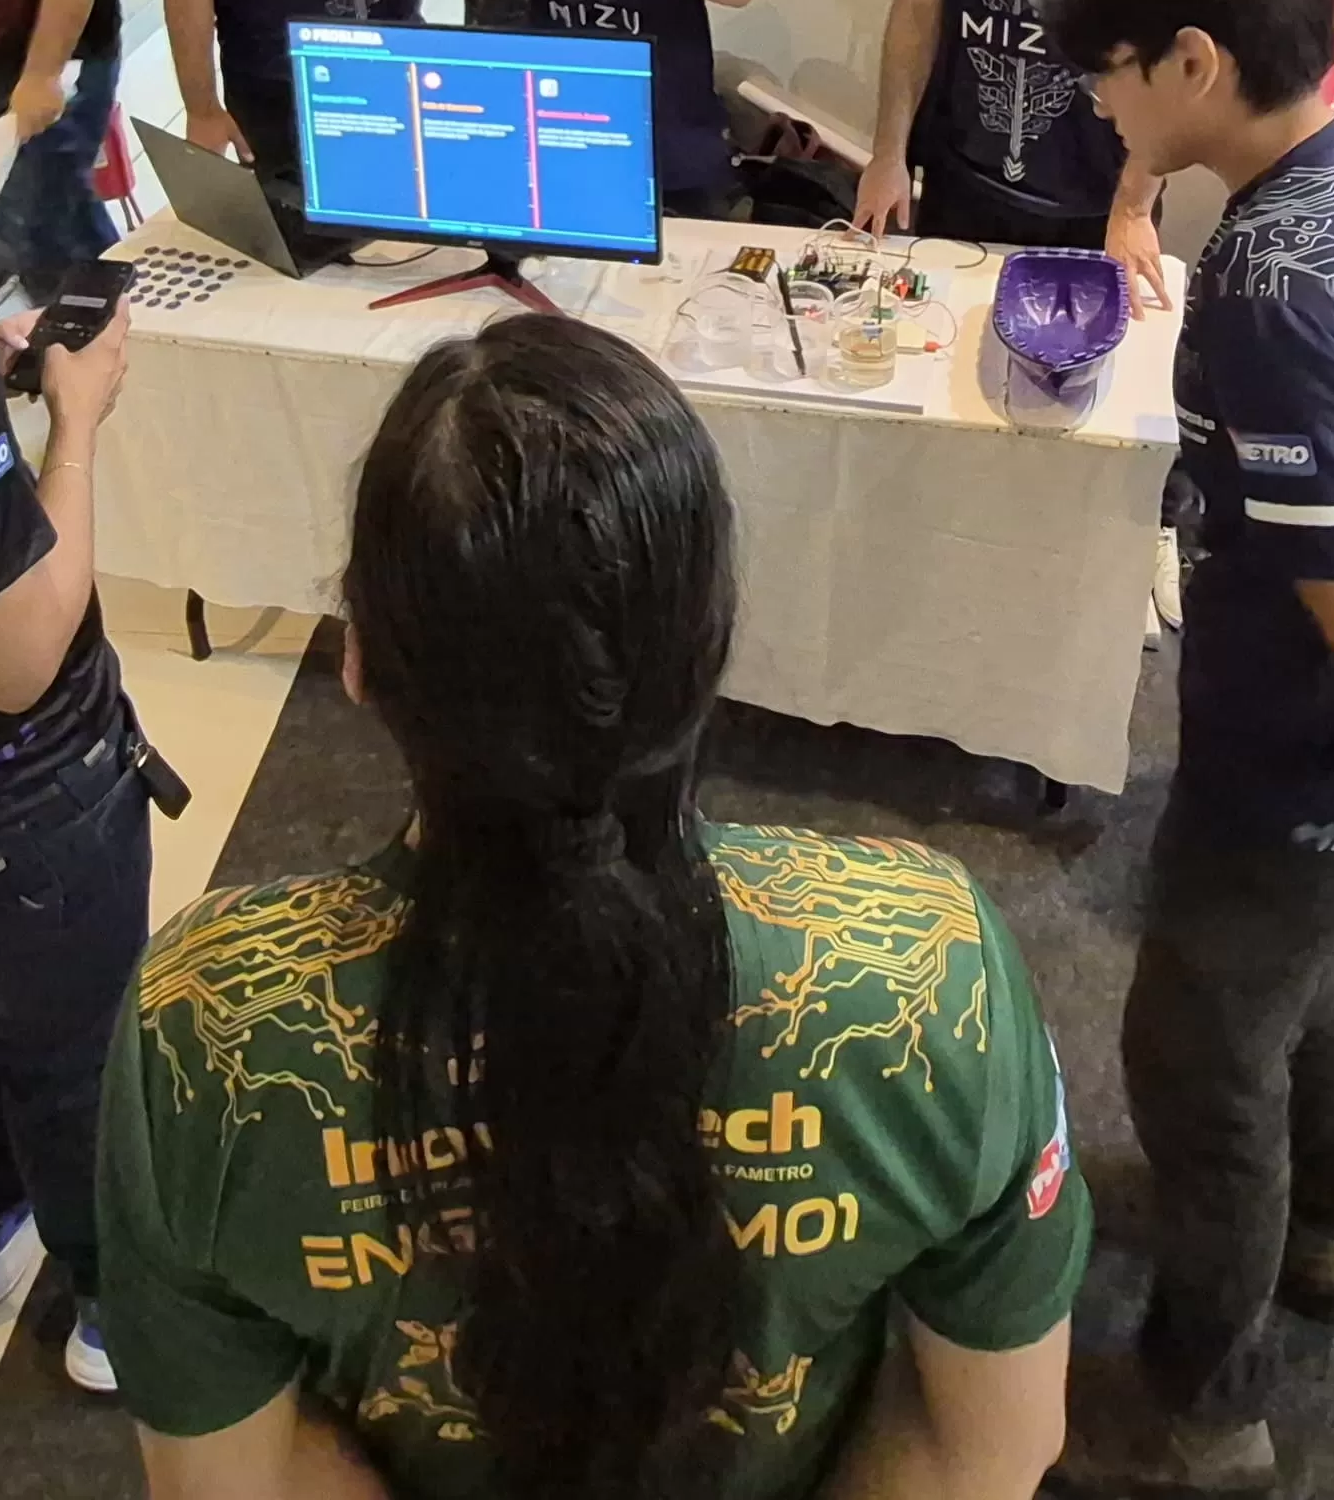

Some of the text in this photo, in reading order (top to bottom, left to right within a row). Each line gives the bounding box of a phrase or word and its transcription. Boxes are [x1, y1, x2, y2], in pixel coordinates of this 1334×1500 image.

[549, 0, 639, 35] MIZU
[961, 11, 1046, 54] MIZ
[724, 1162, 814, 1182] FAMETRO
